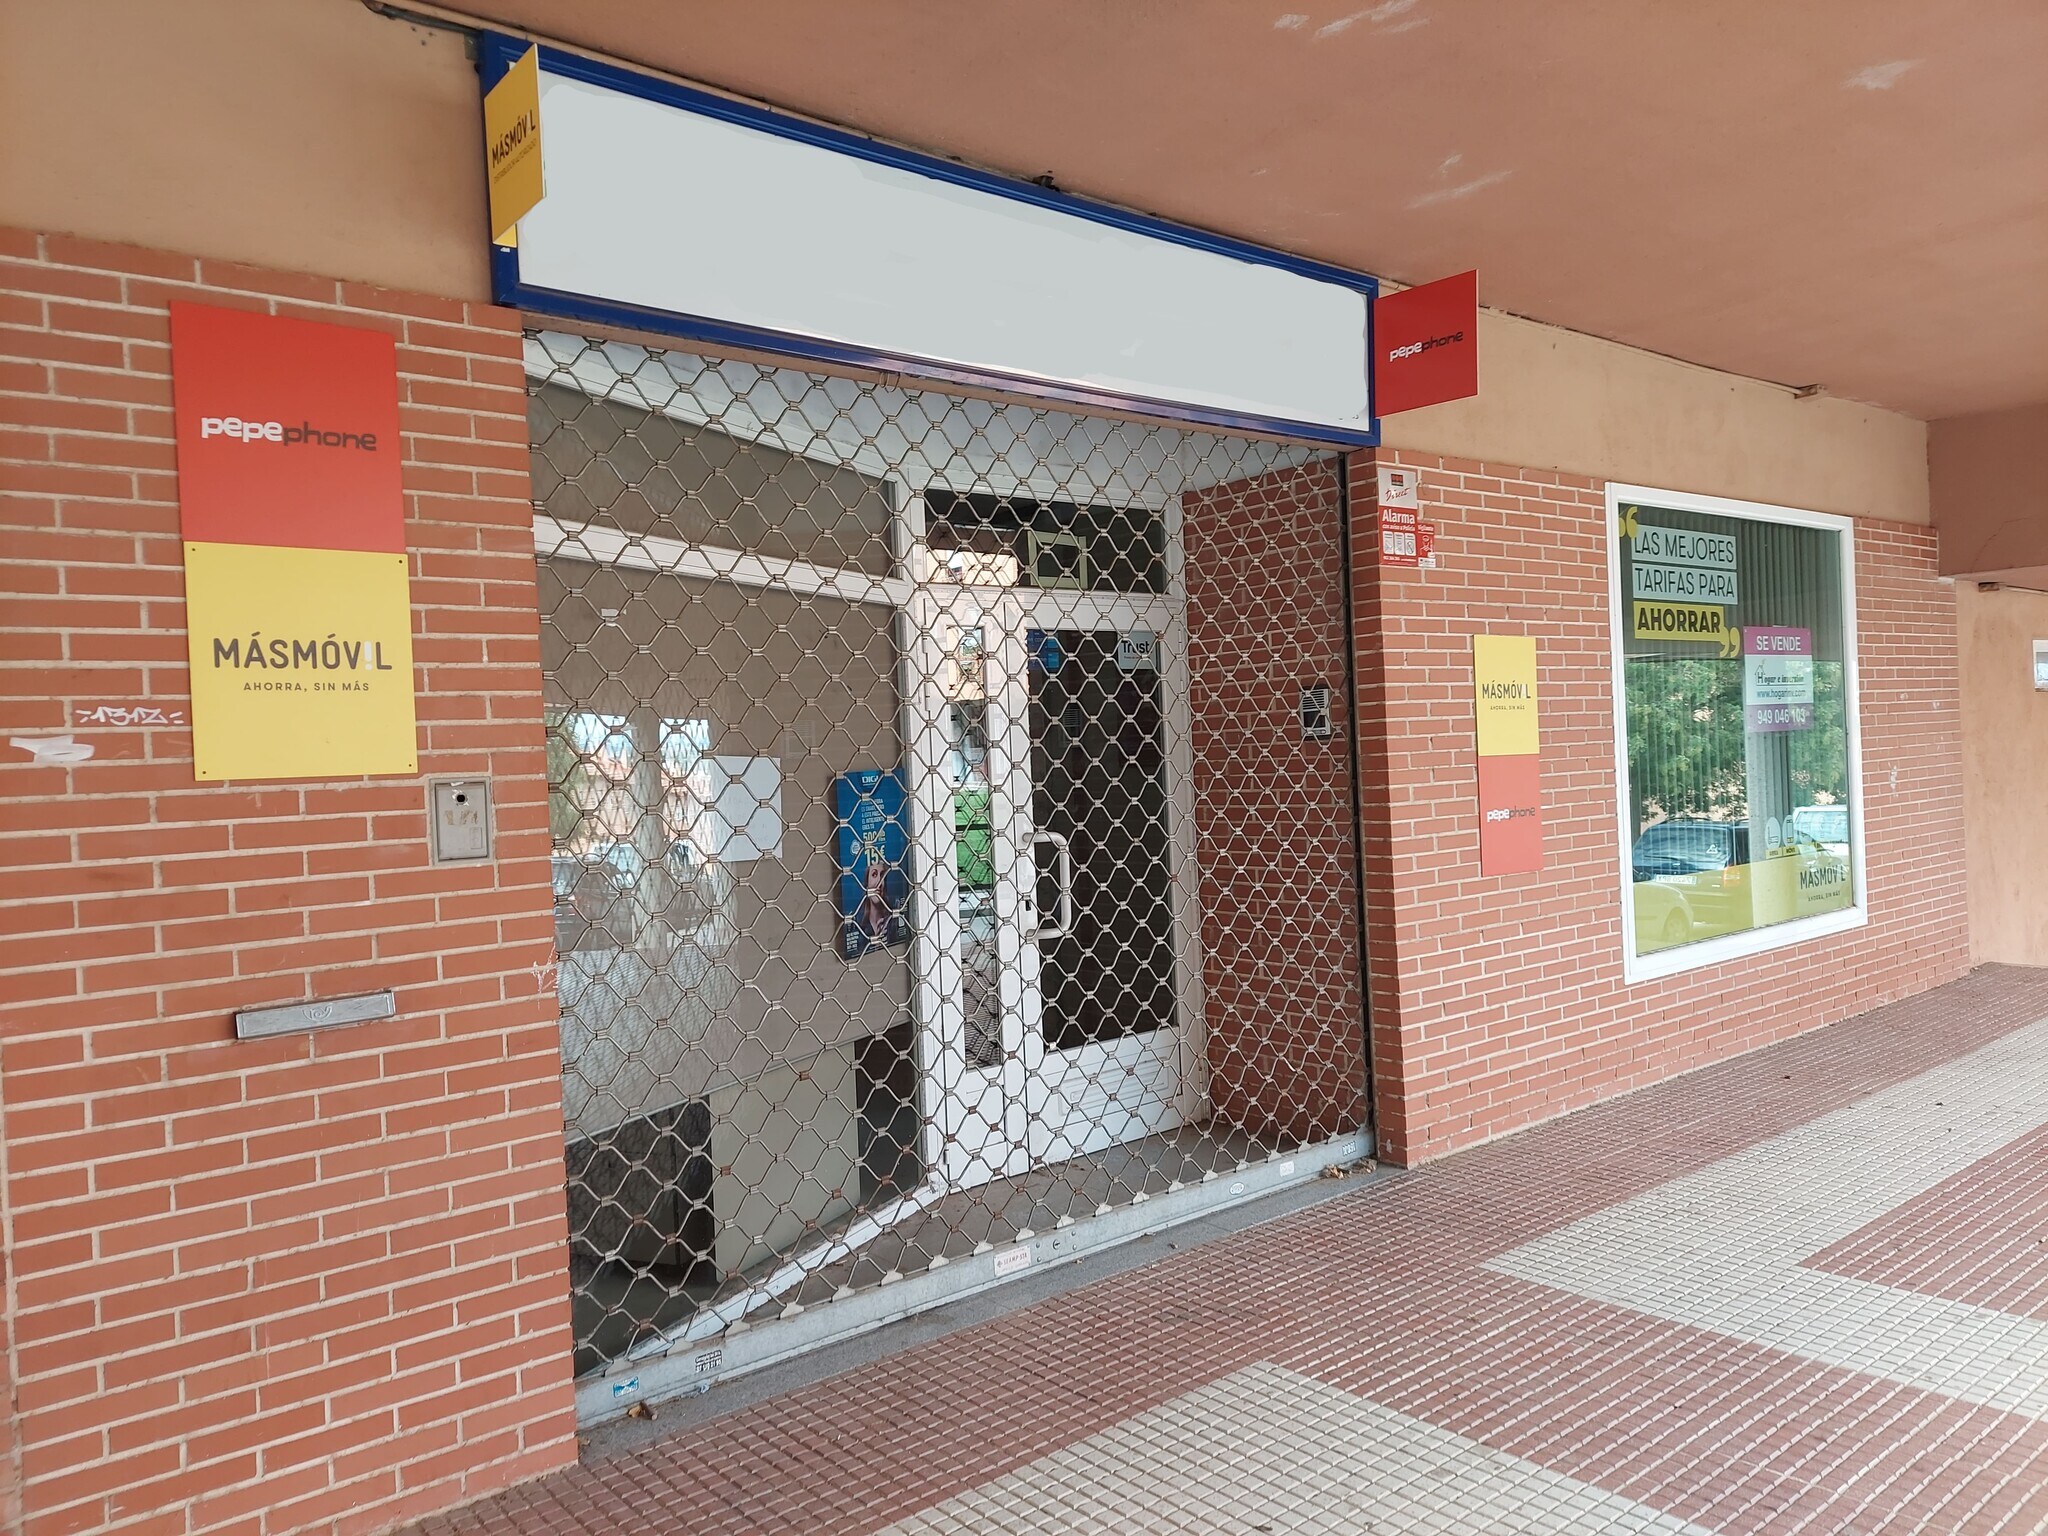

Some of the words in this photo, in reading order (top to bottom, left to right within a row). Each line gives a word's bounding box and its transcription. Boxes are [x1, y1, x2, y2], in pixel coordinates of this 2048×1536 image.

[1389, 331, 1463, 362] pepephone
[201, 416, 377, 451] pepephone
[1382, 509, 1415, 525] Alarma
[1634, 531, 1660, 556] LAS
[1665, 535, 1734, 563] MEJORES
[1634, 567, 1694, 595] TARIFAS
[1700, 573, 1735, 598] PARA
[1637, 607, 1721, 634] AHORRAR
[1756, 635, 1769, 651] SE
[1771, 636, 1801, 651] VENDE
[243, 682, 307, 693] AHORRA,
[314, 682, 336, 692] SIN
[342, 680, 370, 692] MÁS
[1757, 709, 1773, 724] 949
[1774, 709, 1790, 724] 046
[1487, 806, 1536, 823] pepephone
